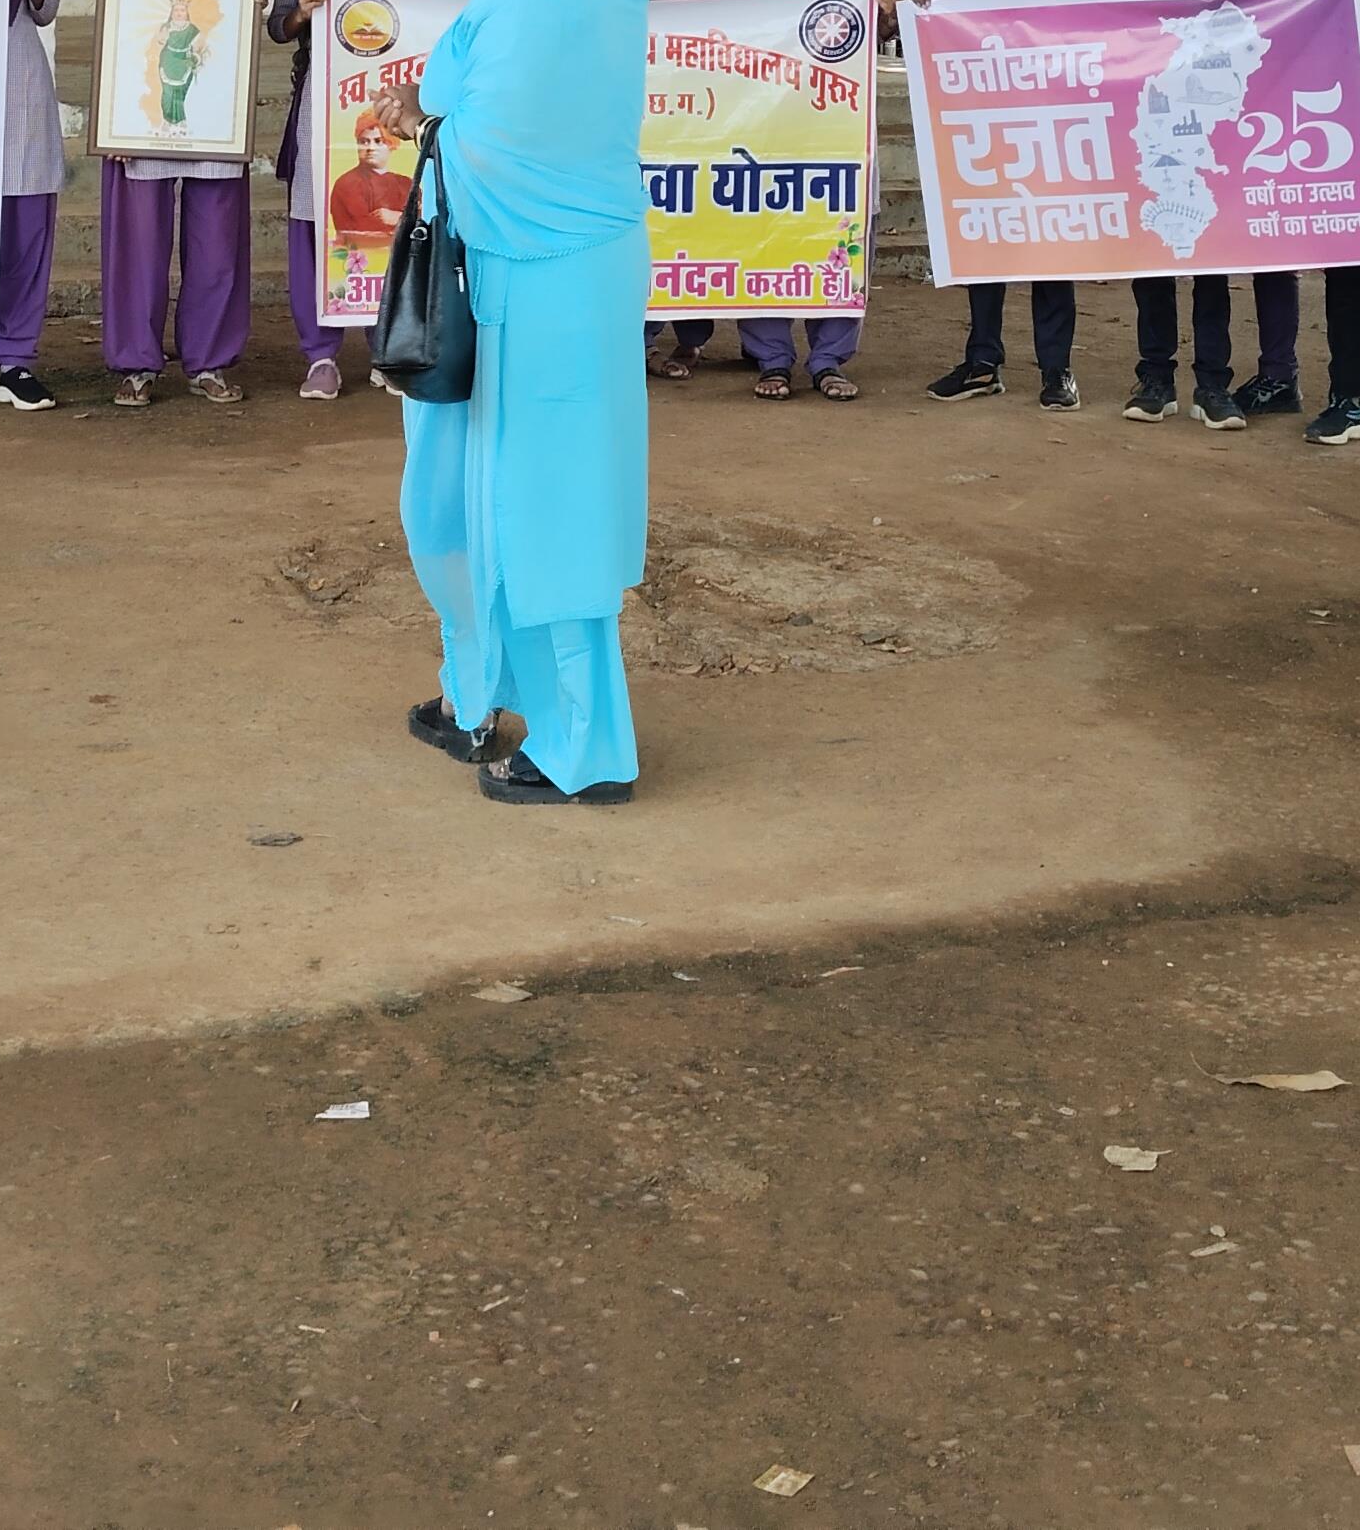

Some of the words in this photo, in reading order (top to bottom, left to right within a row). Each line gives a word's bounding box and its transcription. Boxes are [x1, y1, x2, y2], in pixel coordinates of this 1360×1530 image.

[664, 28, 803, 91] महाविद्यालय
[930, 35, 1108, 98] छत्तीसगढ़
[647, 86, 716, 120] छ.ग.)
[1237, 81, 1354, 174] 25
[940, 101, 1115, 187] रजत
[710, 147, 862, 213] योजना
[1277, 184, 1303, 204] का
[1305, 180, 1356, 203] उत्सव
[952, 182, 1130, 244] महोत्सव
[1281, 215, 1308, 236] का
[649, 251, 739, 298] नंदन
[745, 263, 814, 298] करती
